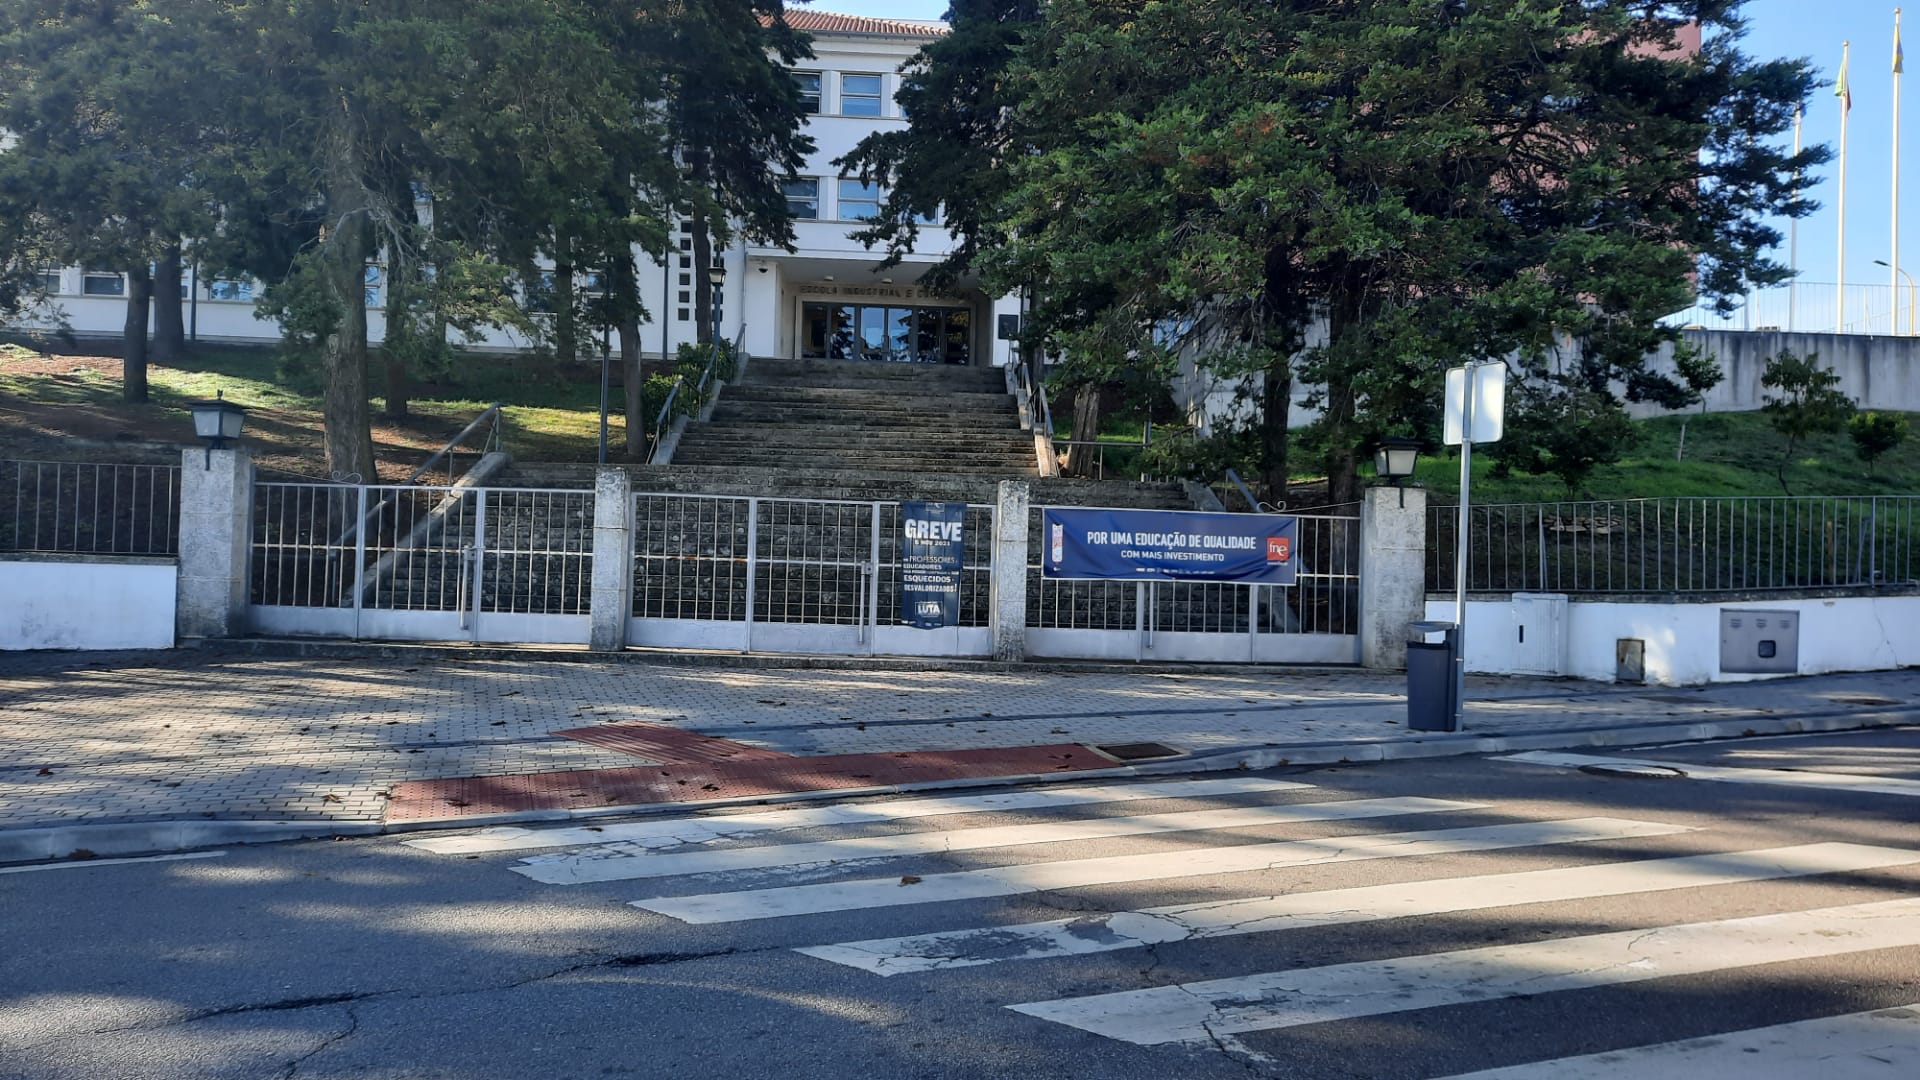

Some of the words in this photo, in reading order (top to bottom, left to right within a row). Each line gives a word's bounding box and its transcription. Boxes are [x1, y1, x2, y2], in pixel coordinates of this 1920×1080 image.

[800, 285, 837, 294] ESCOLA
[845, 287, 900, 298] INDUSTRIAL
[906, 289, 913, 297] E
[905, 519, 962, 541] GREVE
[1087, 531, 1108, 545] POR
[1110, 532, 1133, 546] UMA
[1135, 531, 1186, 550] EDUCAÇÃO
[1188, 535, 1201, 548] DE
[1203, 535, 1257, 550] QUALIDADE
[1269, 540, 1288, 557] fne
[1121, 549, 1140, 559] COM
[1142, 550, 1162, 560] MAIS
[1164, 551, 1225, 562] INVESTIMENTO
[904, 575, 951, 583] ESQUECIDOS
[904, 584, 957, 592] DESVALORIZADOS!
[918, 604, 940, 614] LUTA
